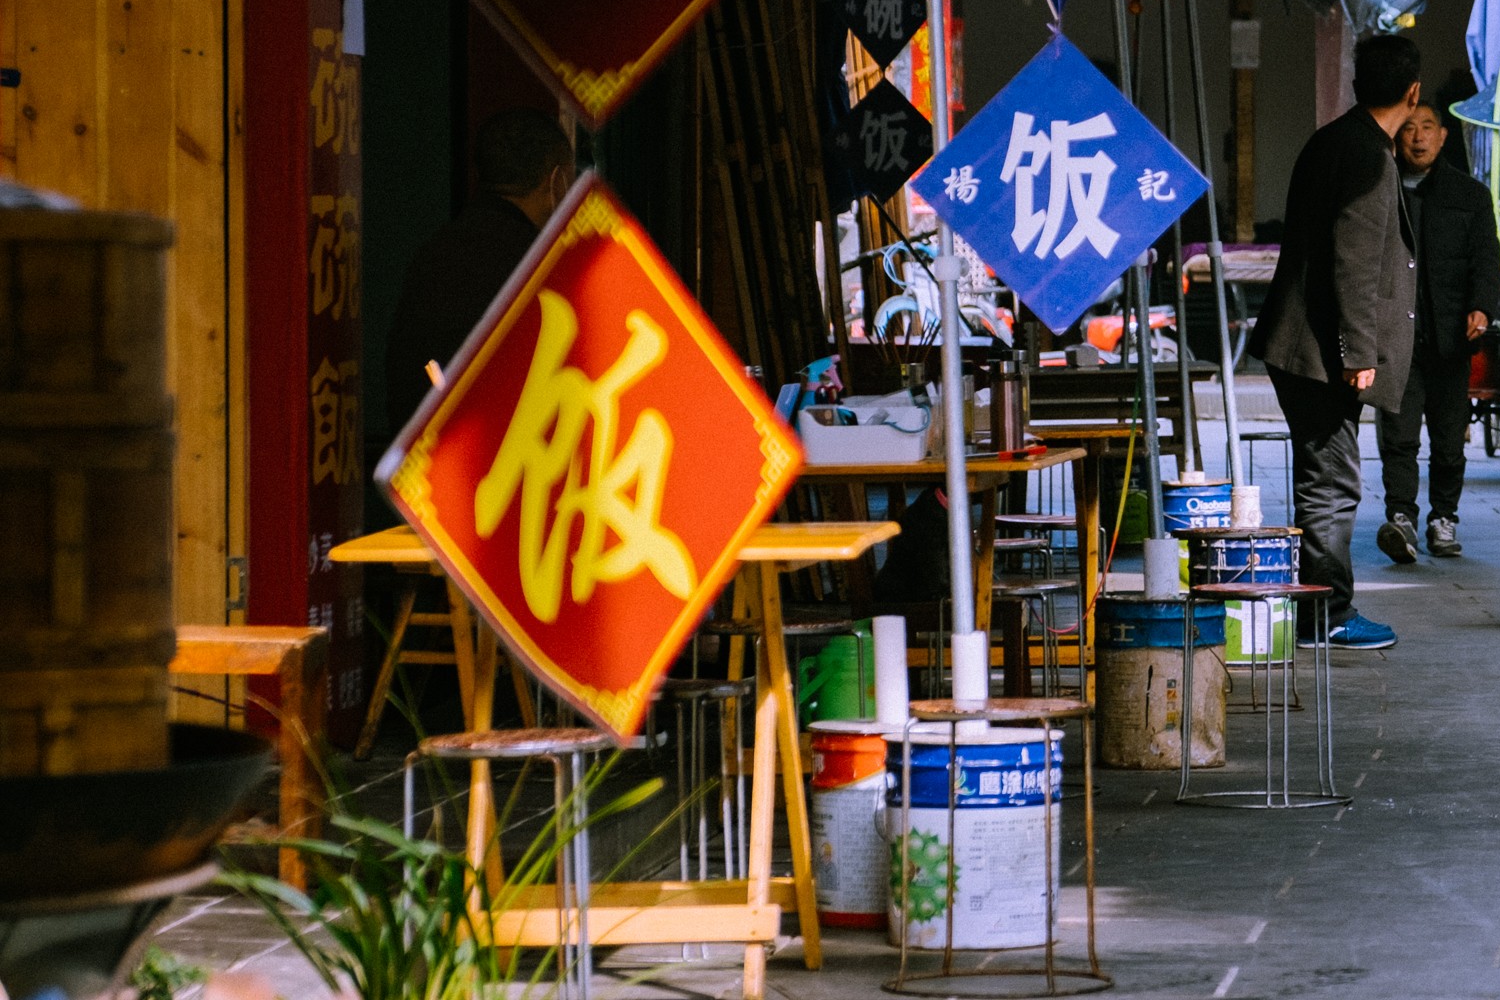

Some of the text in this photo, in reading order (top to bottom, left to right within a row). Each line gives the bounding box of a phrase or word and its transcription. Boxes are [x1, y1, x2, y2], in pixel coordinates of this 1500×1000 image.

[859, 110, 909, 172] 饭
[943, 112, 1176, 260] 楊 饭 記
[475, 289, 695, 625] 饭
